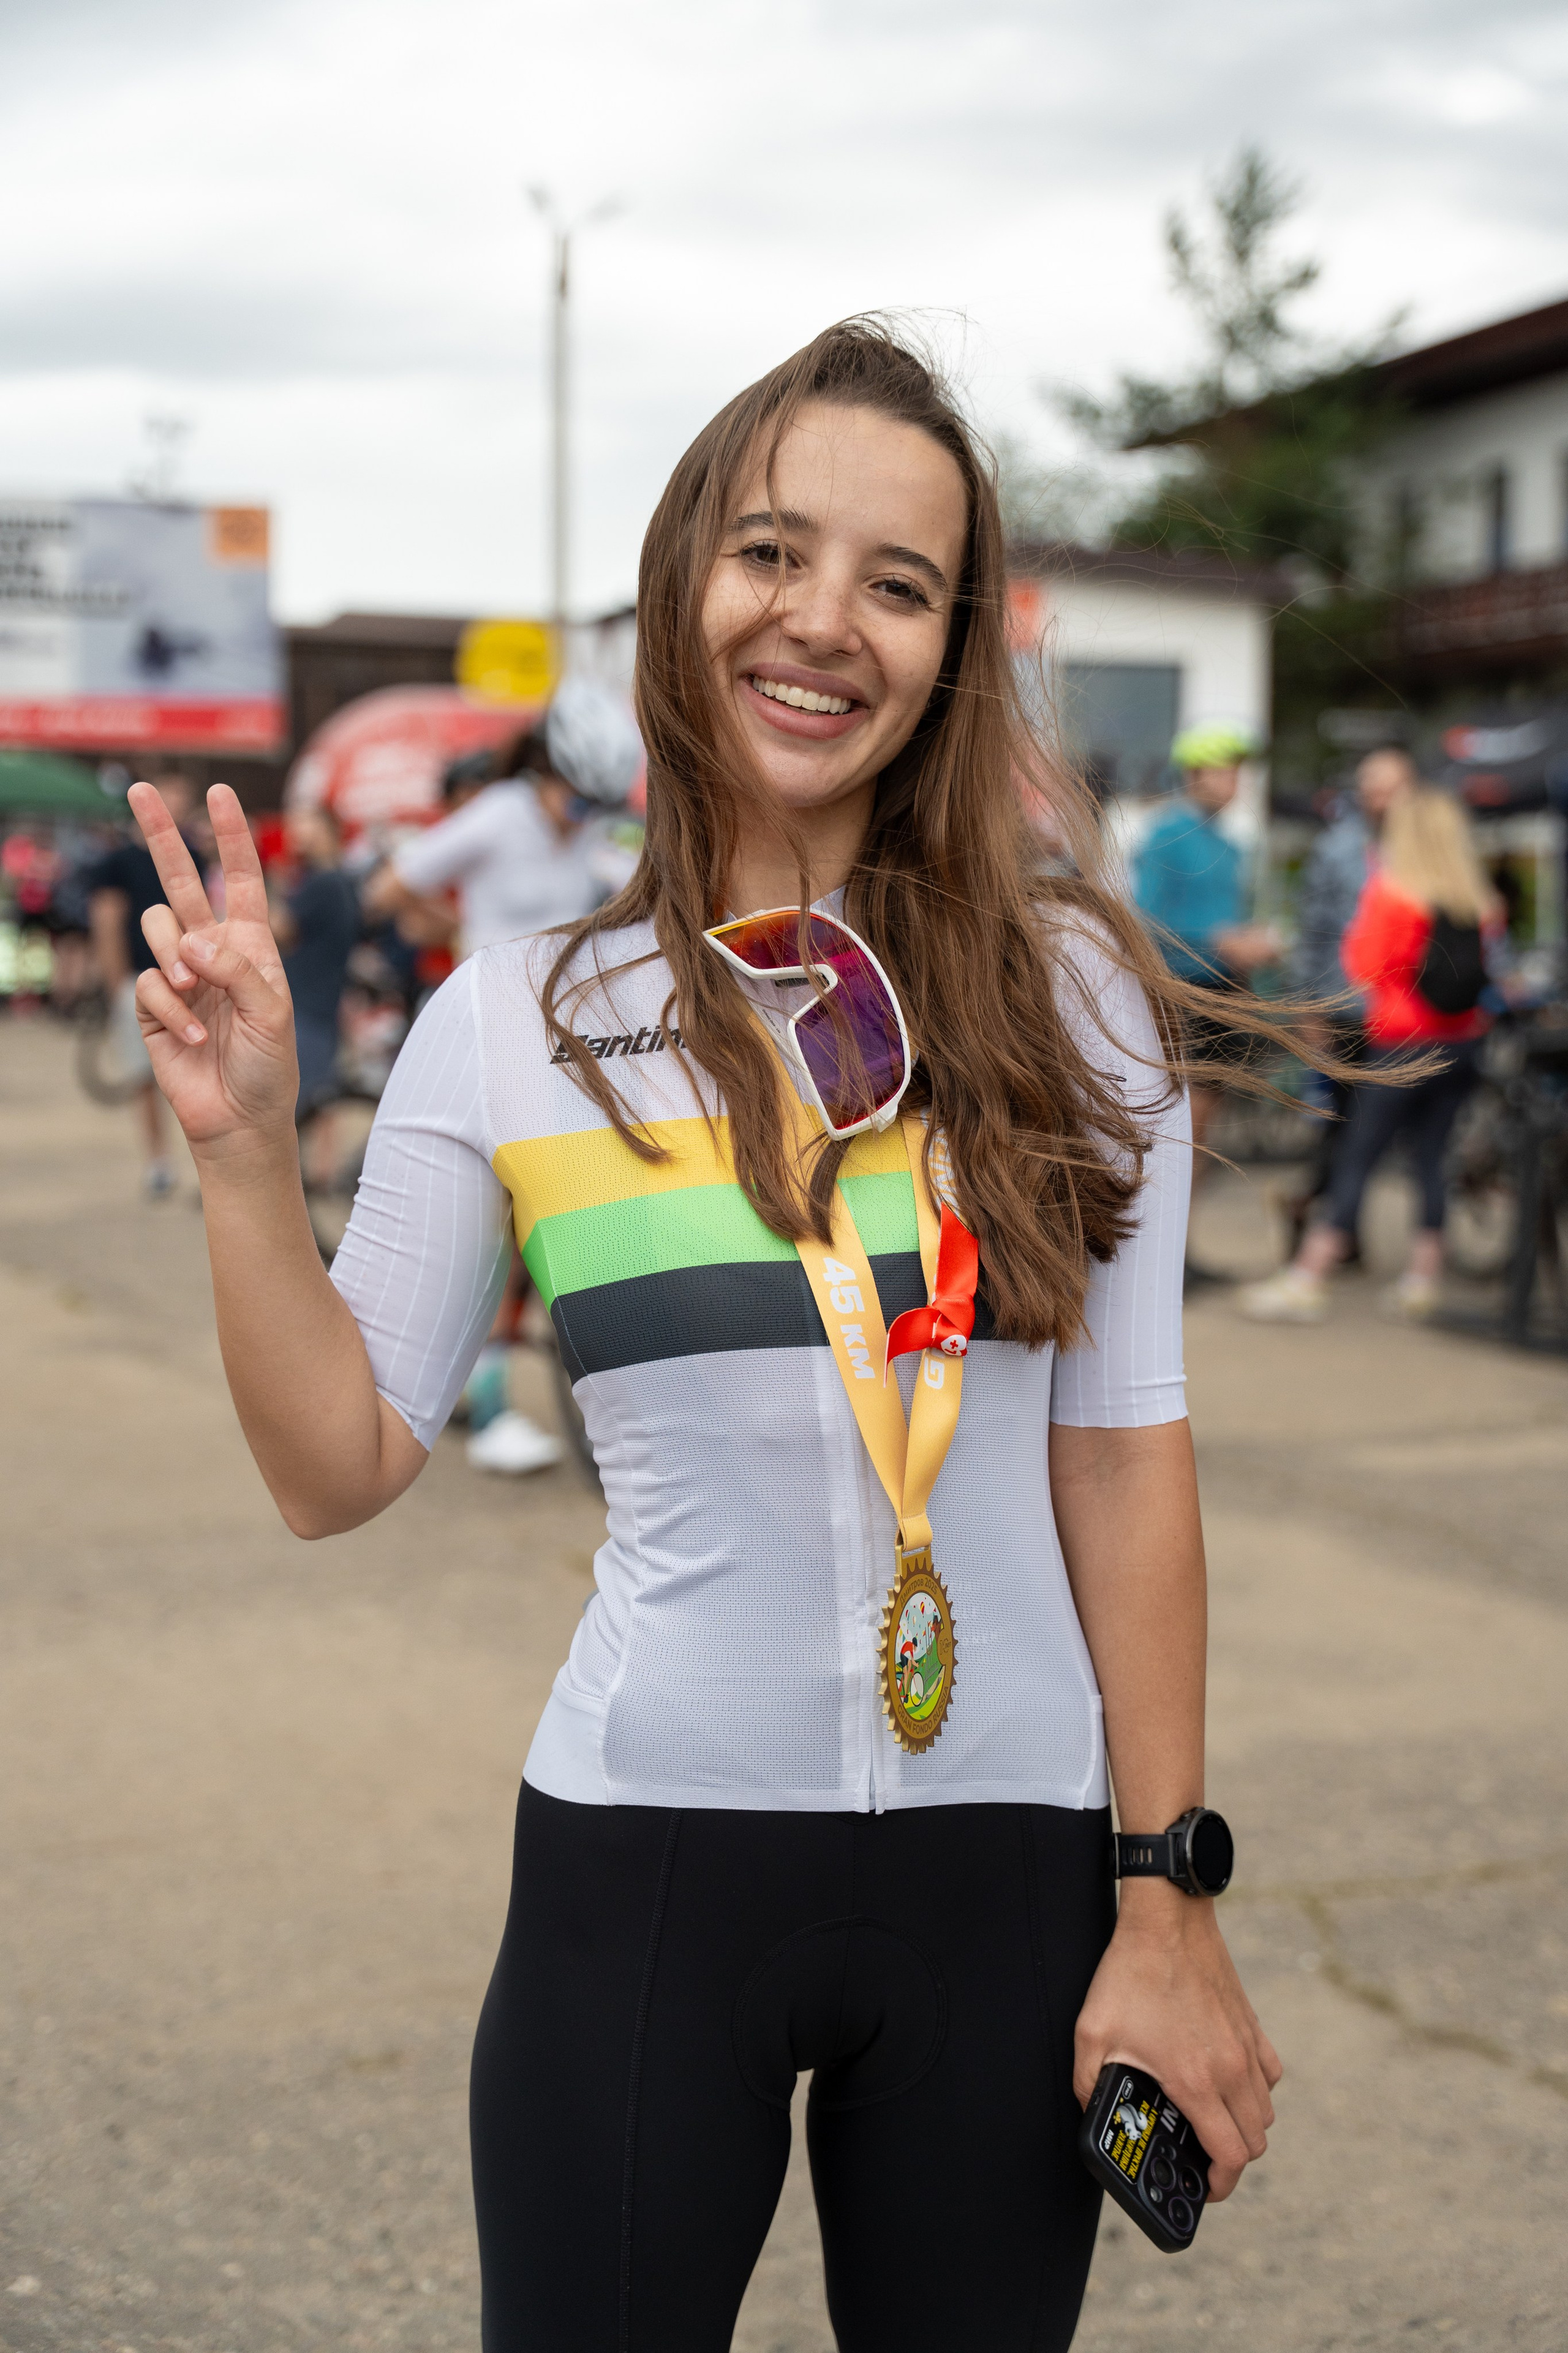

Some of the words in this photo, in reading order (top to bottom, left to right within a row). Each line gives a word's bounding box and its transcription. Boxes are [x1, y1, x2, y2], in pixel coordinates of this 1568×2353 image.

[823, 1257, 865, 1314] 45
[924, 1577, 938, 1595] 2025
[897, 1704, 912, 1731] GRAN
[912, 1721, 933, 1735] FONDO
[933, 1686, 949, 1724] RUSSIA
[1104, 2129, 1114, 2150] МИР
